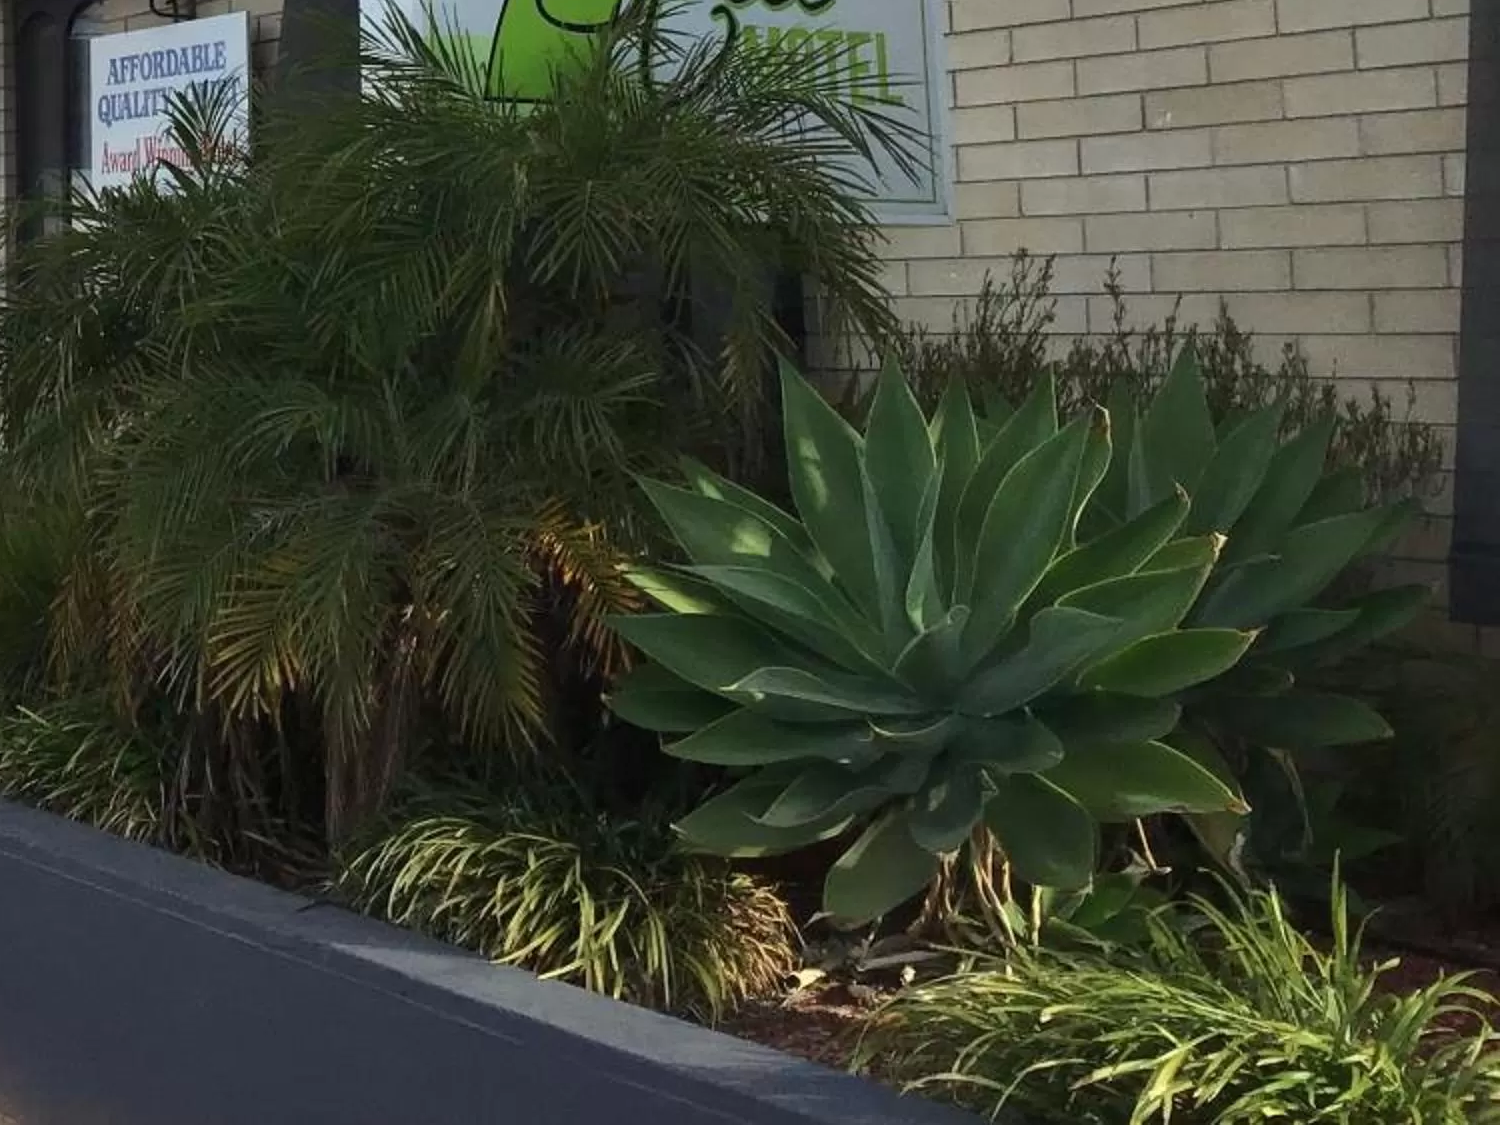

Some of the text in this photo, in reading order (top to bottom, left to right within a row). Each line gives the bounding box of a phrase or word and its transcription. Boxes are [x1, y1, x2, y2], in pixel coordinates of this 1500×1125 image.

[107, 41, 227, 86] AFFORDABLE
[98, 86, 174, 127] QUALITY
[102, 137, 140, 174] Award
